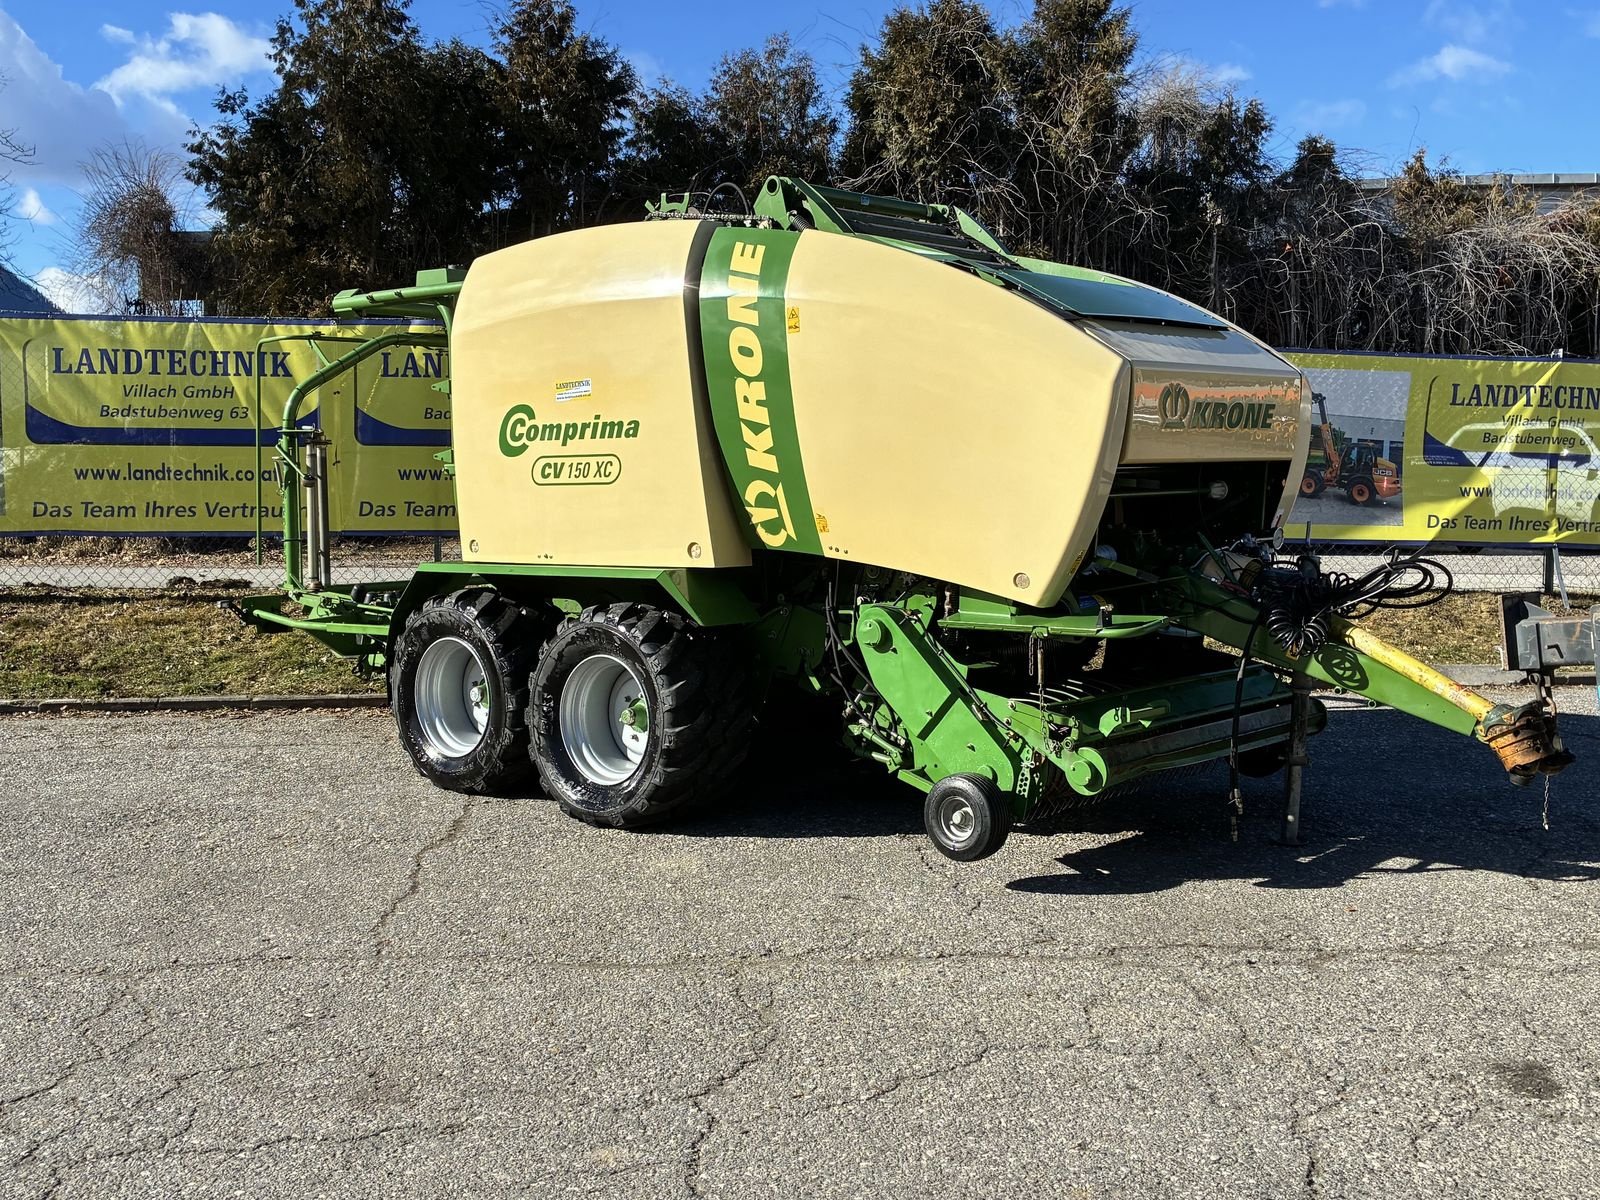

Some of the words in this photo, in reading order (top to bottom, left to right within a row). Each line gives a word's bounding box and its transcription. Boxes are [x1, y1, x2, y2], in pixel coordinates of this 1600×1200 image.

[53, 347, 293, 377] LANDTECHNIK
[381, 352, 450, 378] LAN
[727, 241, 779, 473] KRONE
[122, 384, 177, 399] Villach
[182, 386, 235, 400] GmbH
[99, 404, 223, 423] Badstubenweg
[229, 406, 249, 420] 63
[1189, 401, 1276, 429] KRONE
[1502, 414, 1543, 427] Villach
[1482, 432, 1576, 449] Badstubenweg
[74, 462, 279, 482] www.landtechnik.coat
[540, 462, 565, 479] CV
[567, 462, 591, 479] 150
[593, 460, 614, 478] XC
[1373, 469, 1393, 477] JCB
[32, 501, 73, 519] Das
[81, 501, 136, 519] Team
[144, 501, 197, 519] Ihres
[205, 501, 308, 520] Vertraun
[358, 501, 396, 517] Das
[404, 501, 456, 517] Team
[1427, 514, 1458, 530] Das
[1463, 515, 1503, 531] Team
[1508, 515, 1549, 532] Ihres
